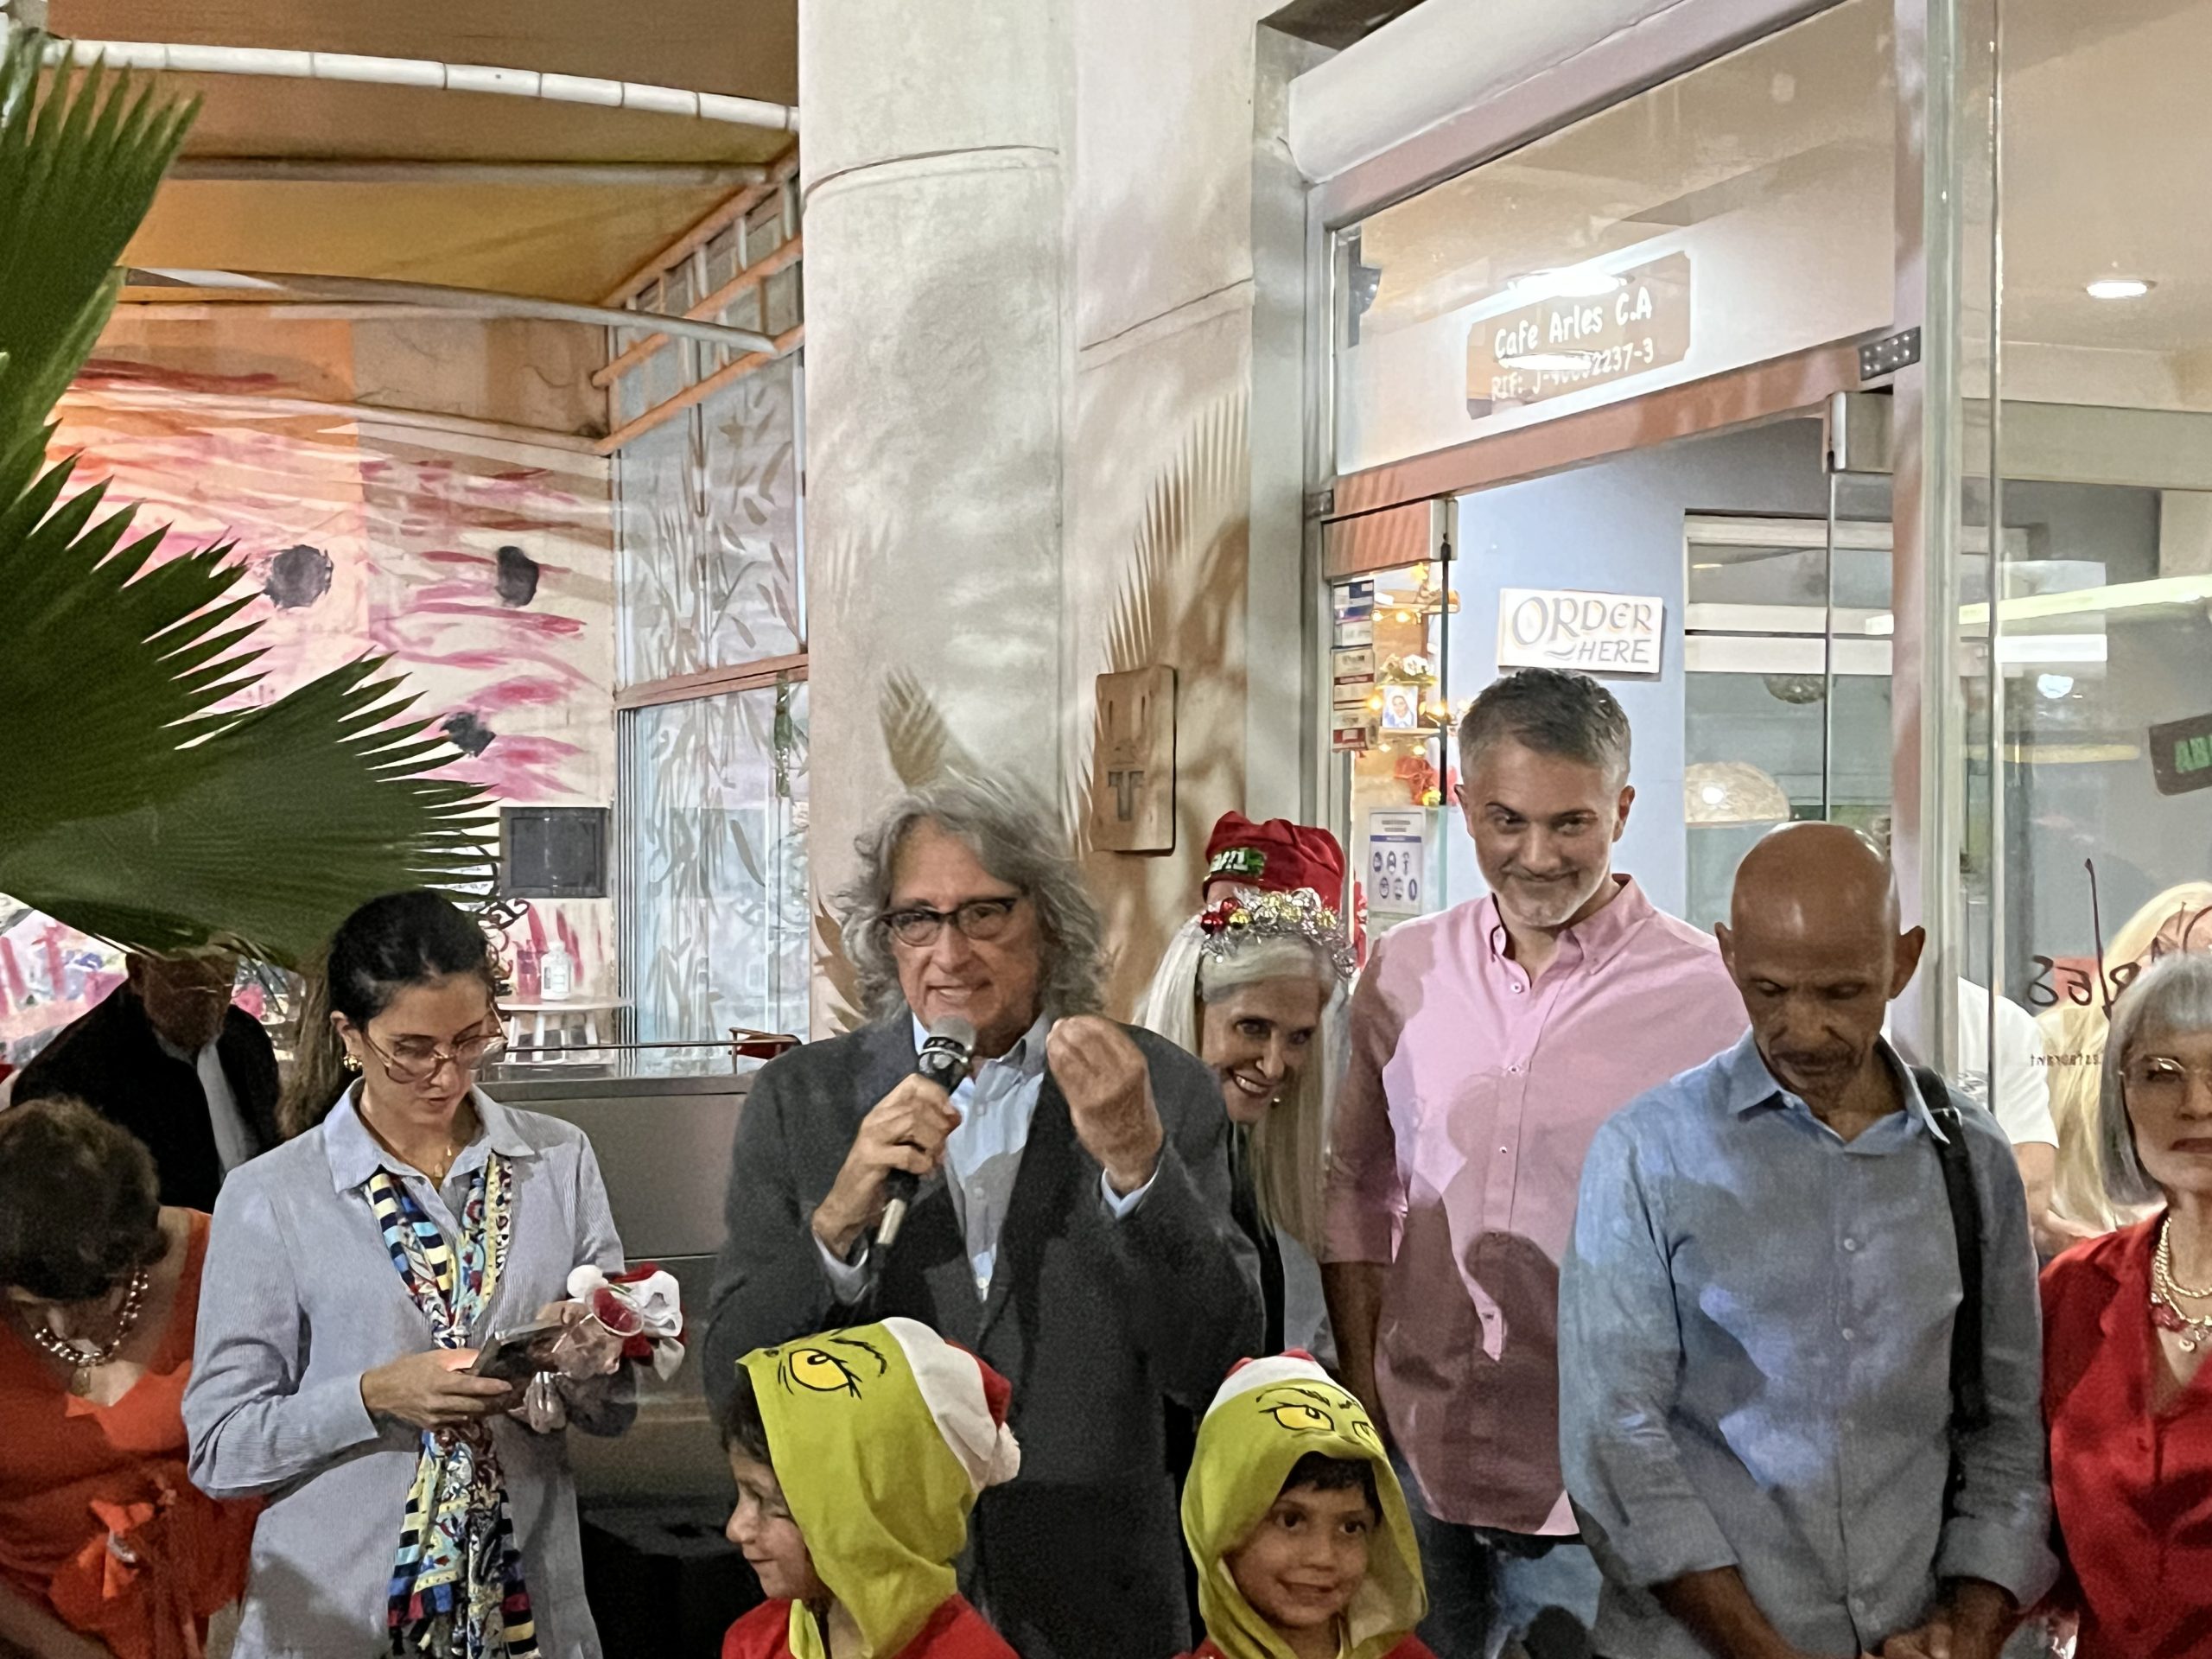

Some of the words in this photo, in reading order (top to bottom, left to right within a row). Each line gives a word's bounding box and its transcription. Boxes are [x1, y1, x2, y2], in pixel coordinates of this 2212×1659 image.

[1495, 320, 1538, 359] Cafe
[1549, 305, 1603, 343] Arles
[1616, 286, 1652, 326] C.A
[1491, 372, 1523, 402] RIF:
[1512, 596, 1653, 645] ORDER
[1576, 639, 1651, 664] HERE
